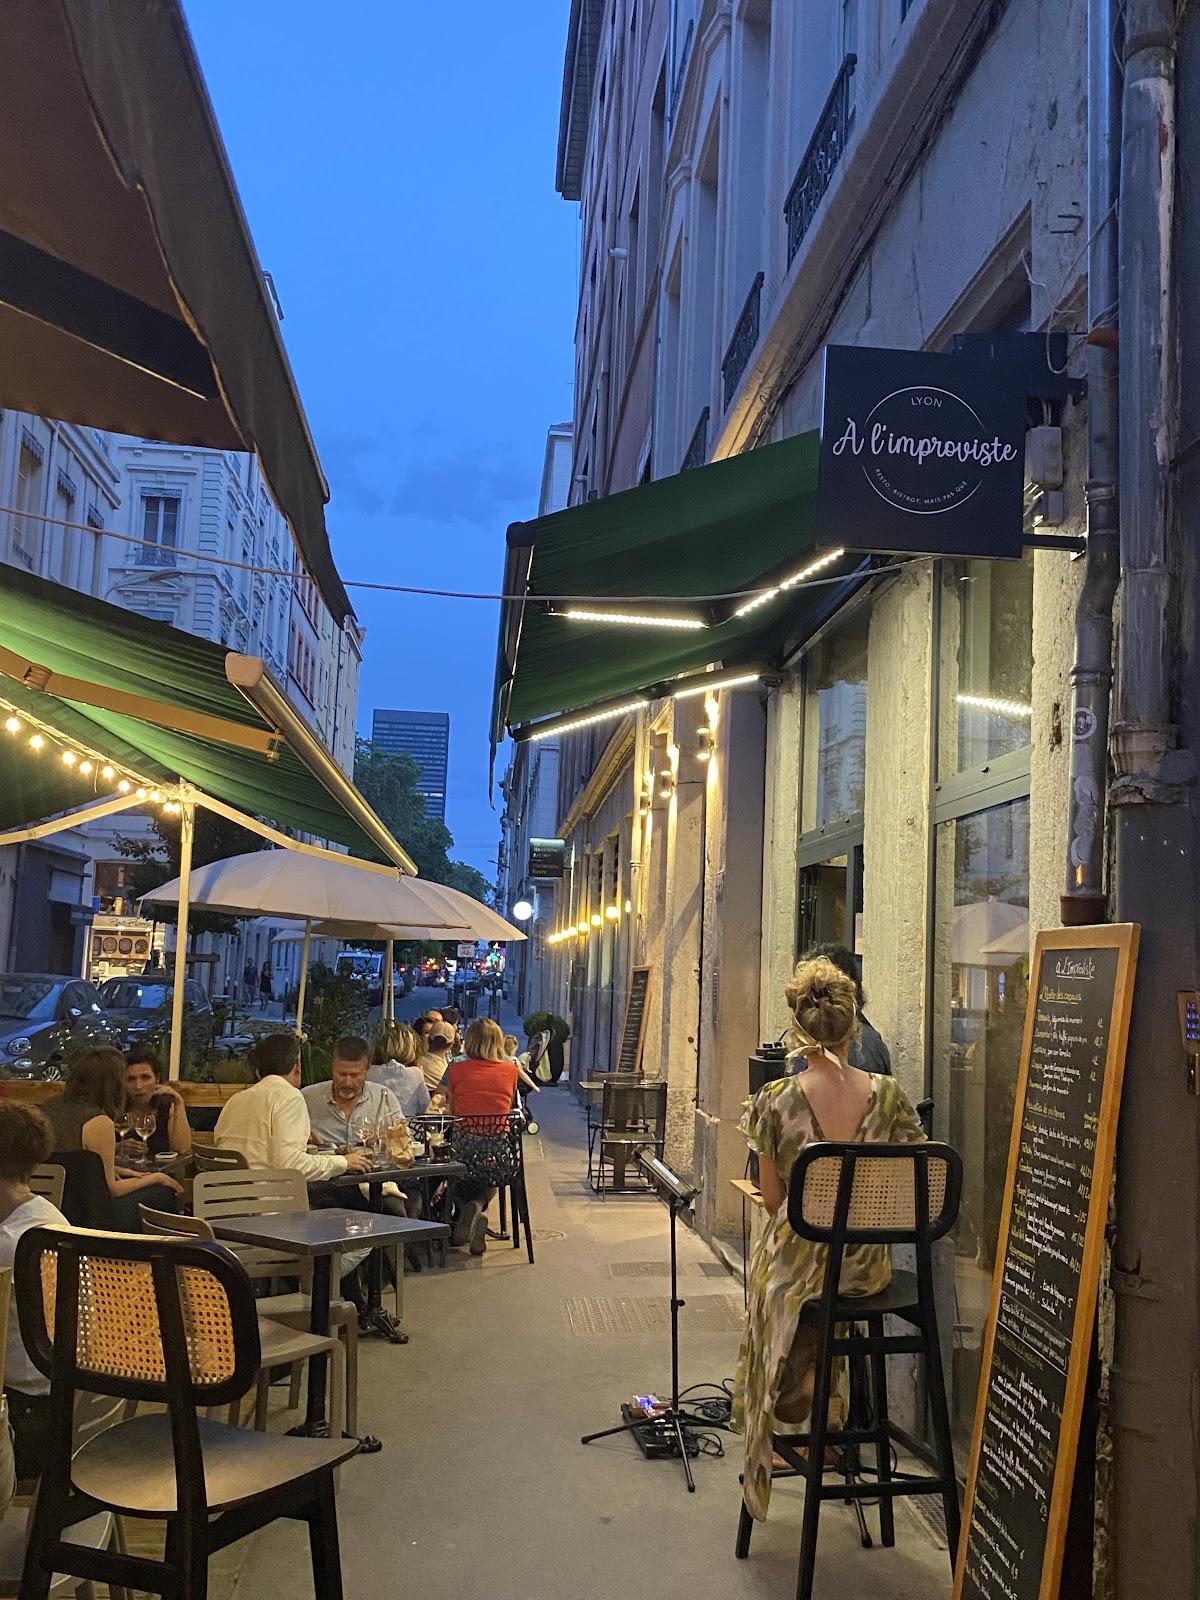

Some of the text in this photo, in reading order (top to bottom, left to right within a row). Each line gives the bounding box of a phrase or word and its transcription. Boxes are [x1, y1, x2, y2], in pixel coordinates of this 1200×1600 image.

[911, 396, 942, 408] LYON
[832, 417, 1018, 467] À l'improviste
[893, 488, 922, 504] BISTROT,
[924, 496, 942, 504] MAIS
[943, 491, 955, 500] PAS
